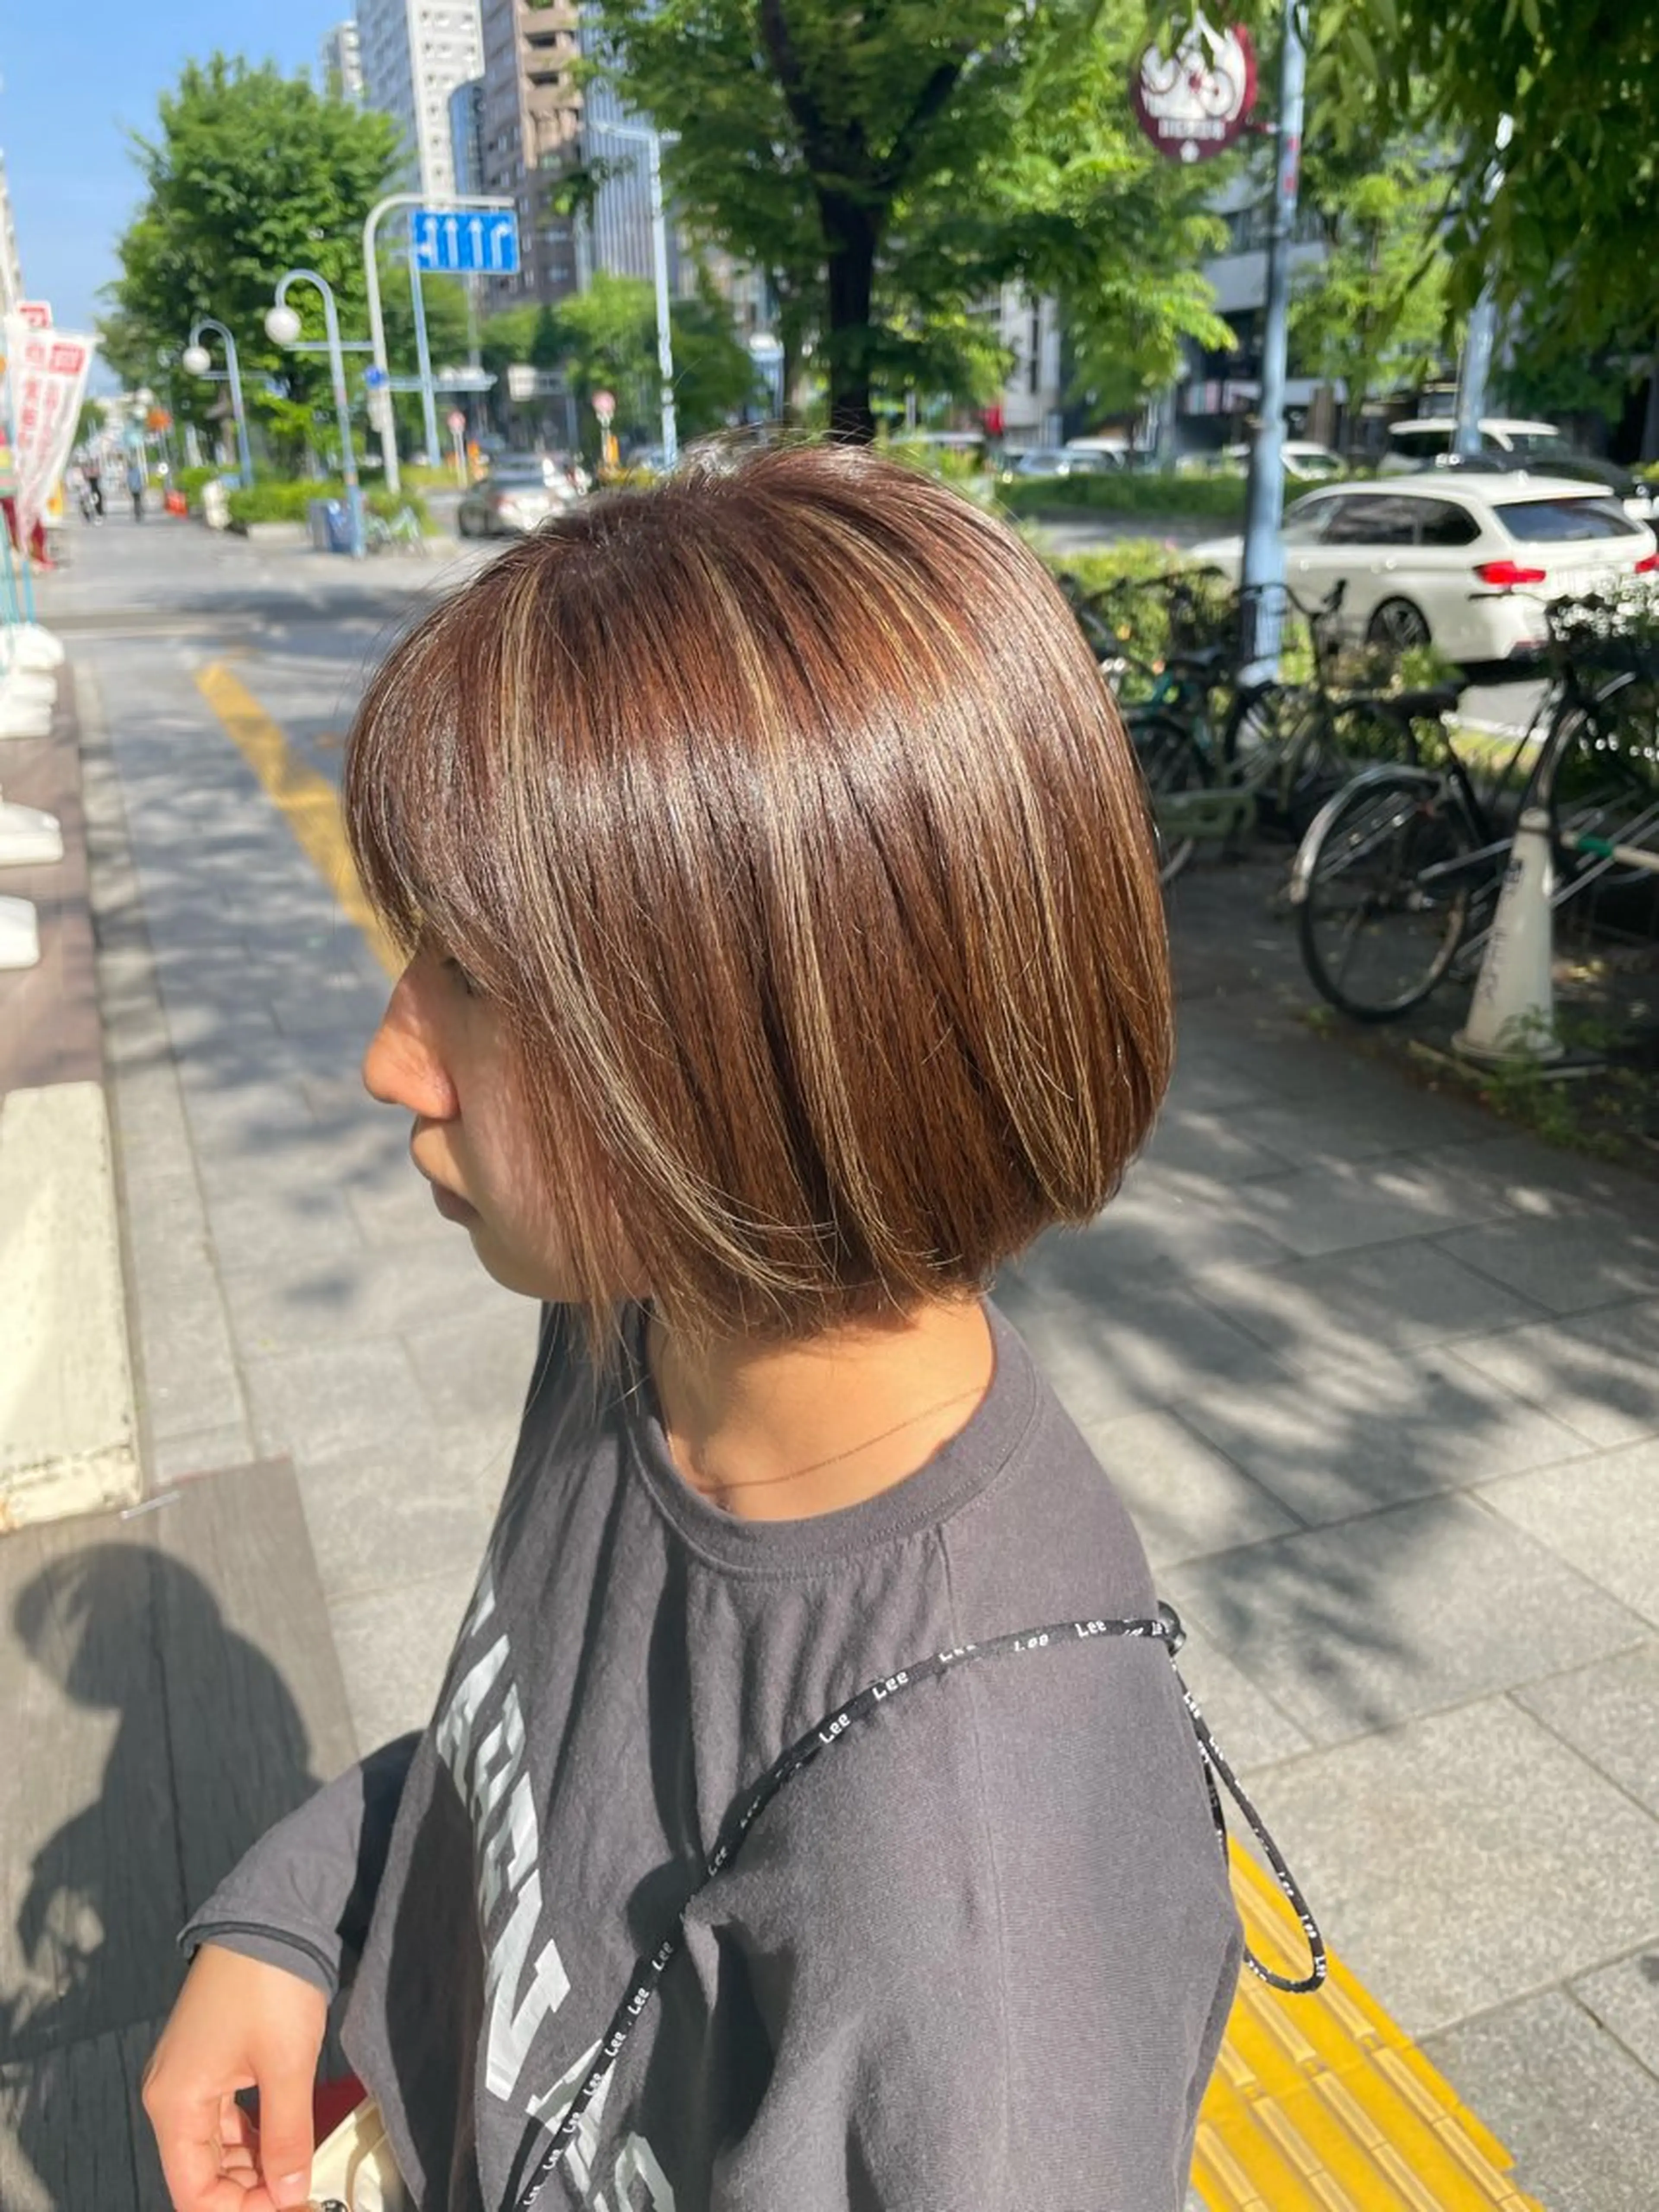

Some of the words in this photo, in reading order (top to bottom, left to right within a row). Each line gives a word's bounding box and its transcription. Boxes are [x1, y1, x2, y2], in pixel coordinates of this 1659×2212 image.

[604, 2031, 626, 2057] Lee
[627, 1987, 649, 2015] Lee
[652, 1941, 674, 1971] Lee
[819, 1713, 851, 1744] Lee
[872, 1671, 909, 1702] Lee
[1074, 1620, 1107, 1638] Lee
